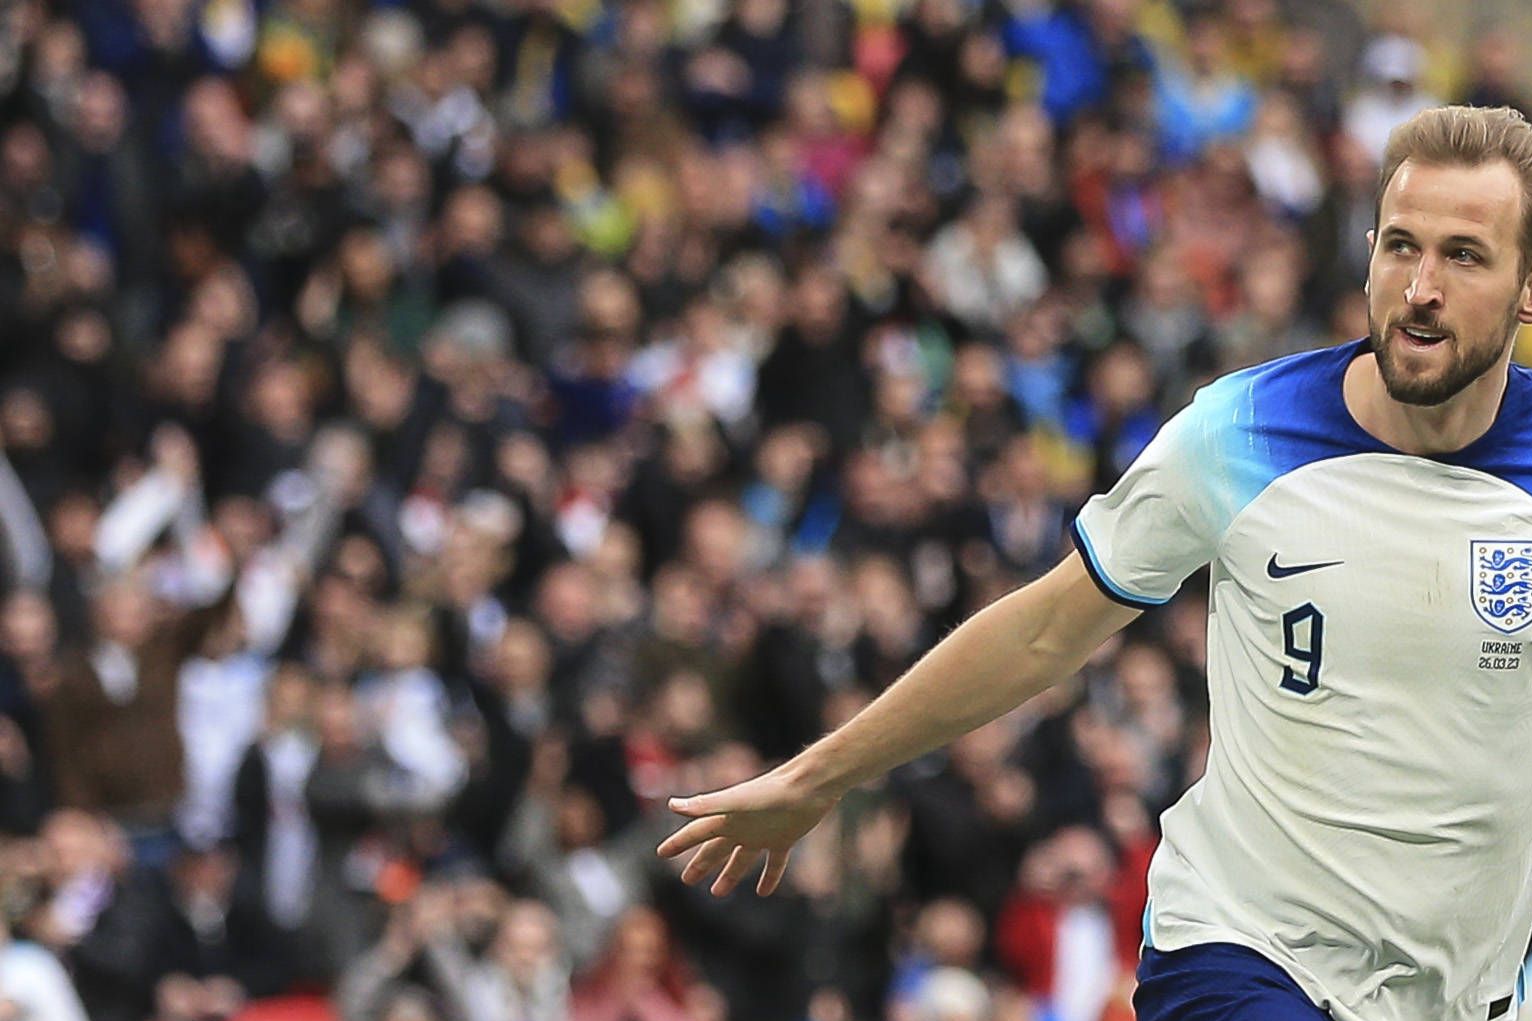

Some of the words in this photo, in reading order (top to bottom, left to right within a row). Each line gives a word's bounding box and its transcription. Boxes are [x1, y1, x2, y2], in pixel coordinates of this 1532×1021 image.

[1279, 601, 1324, 696] 9
[1481, 641, 1523, 655] UKRAINE
[1478, 656, 1520, 670] 26.03.23
